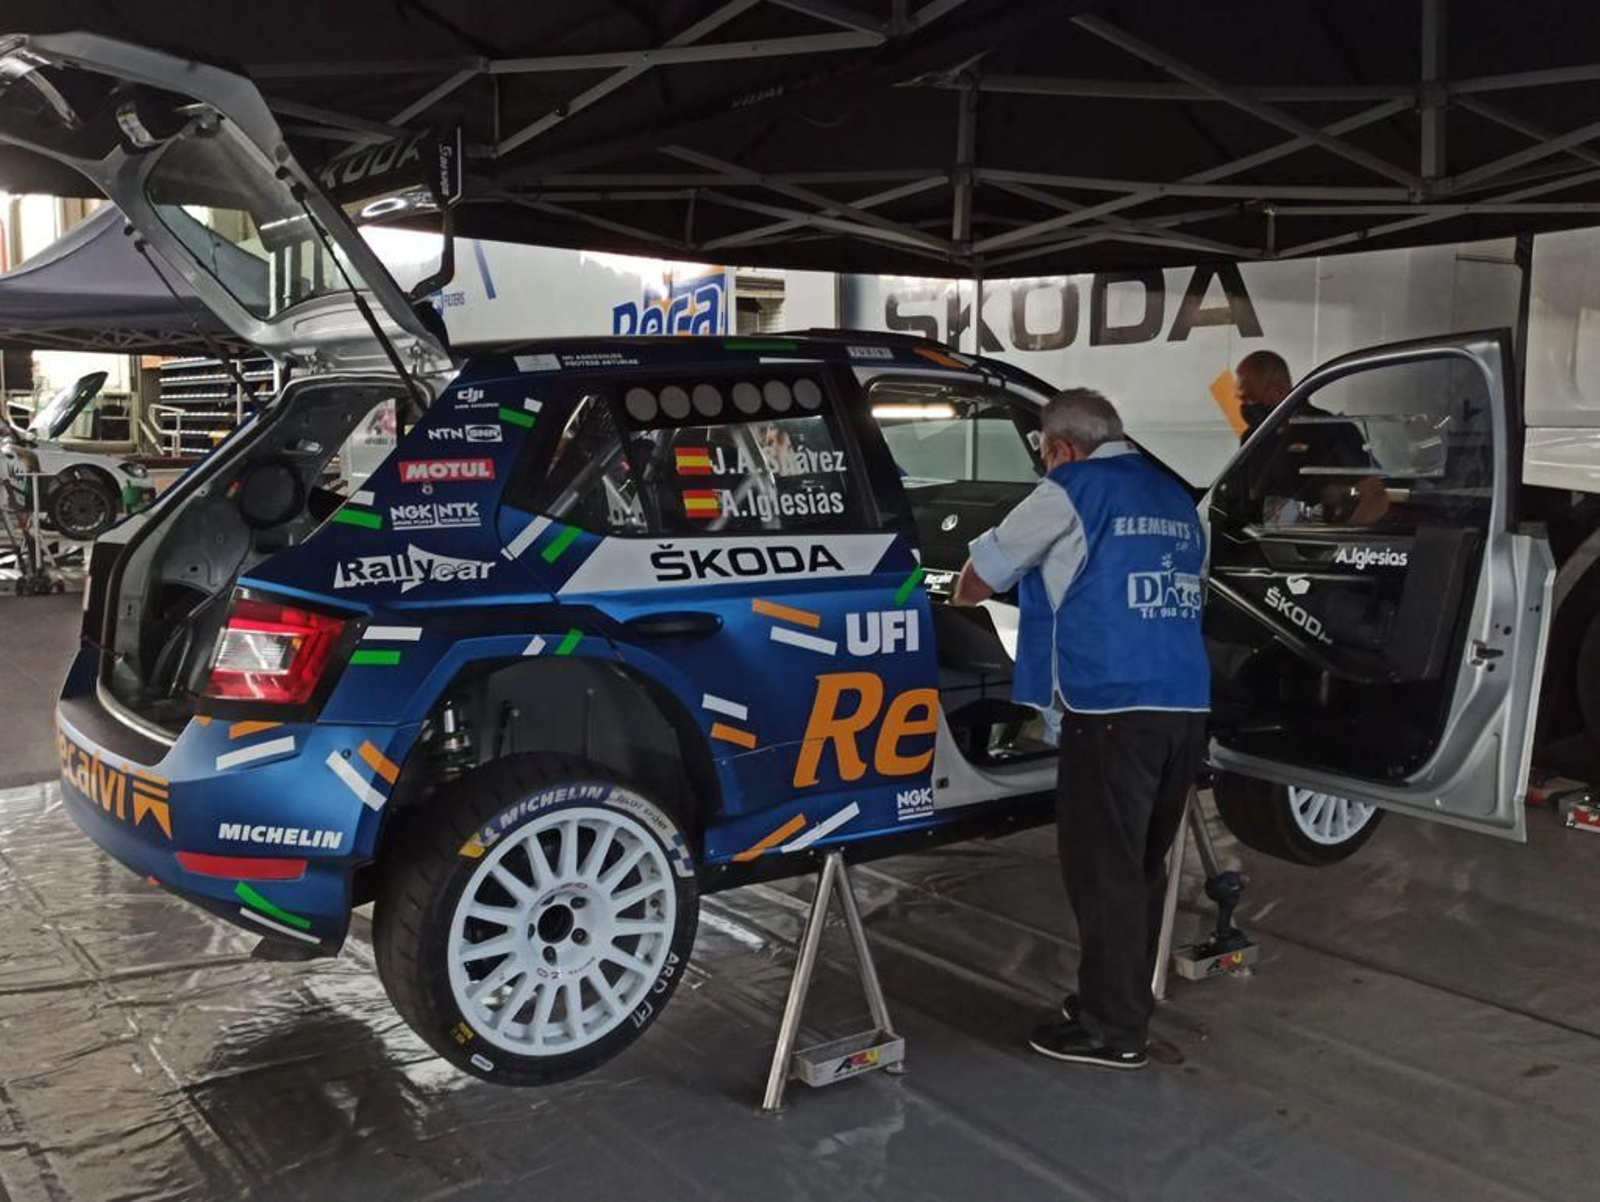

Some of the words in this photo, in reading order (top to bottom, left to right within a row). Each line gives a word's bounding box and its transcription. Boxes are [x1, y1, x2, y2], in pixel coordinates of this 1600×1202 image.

[428, 428, 463, 440] NTN
[406, 462, 490, 480] MOTUL
[390, 504, 432, 520] NGK
[439, 503, 479, 517] NTK
[722, 487, 845, 523] A.Iglesias
[1113, 516, 1191, 540] ELEMENTS
[650, 543, 845, 581] ŠKODA
[1335, 547, 1408, 570] A.Iglesias
[846, 609, 919, 656] UFI
[793, 671, 939, 788] Re
[500, 785, 604, 829] MICHELIN
[897, 787, 932, 808] NGK
[218, 823, 343, 849] MICHELIN
